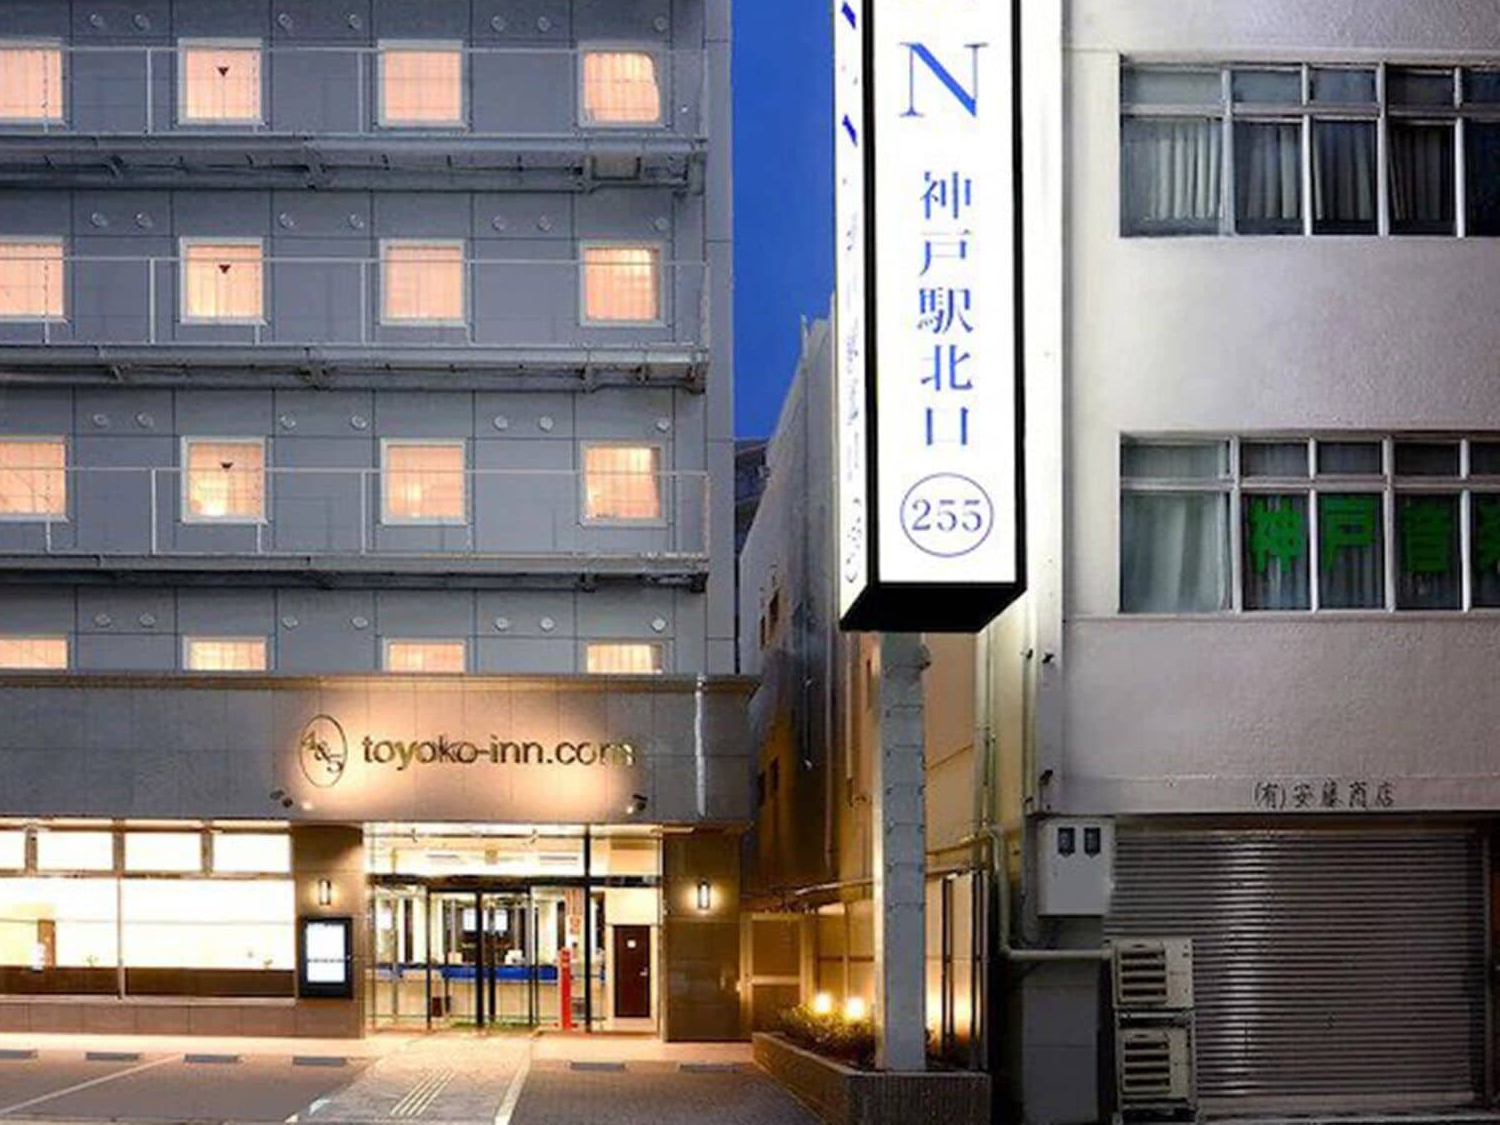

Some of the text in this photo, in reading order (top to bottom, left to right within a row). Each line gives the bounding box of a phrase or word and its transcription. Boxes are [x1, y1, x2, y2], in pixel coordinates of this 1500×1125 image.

[917, 171, 975, 446] 神戸駅北口
[911, 499, 983, 532] 255
[362, 735, 636, 770] toyoko-inn.com
